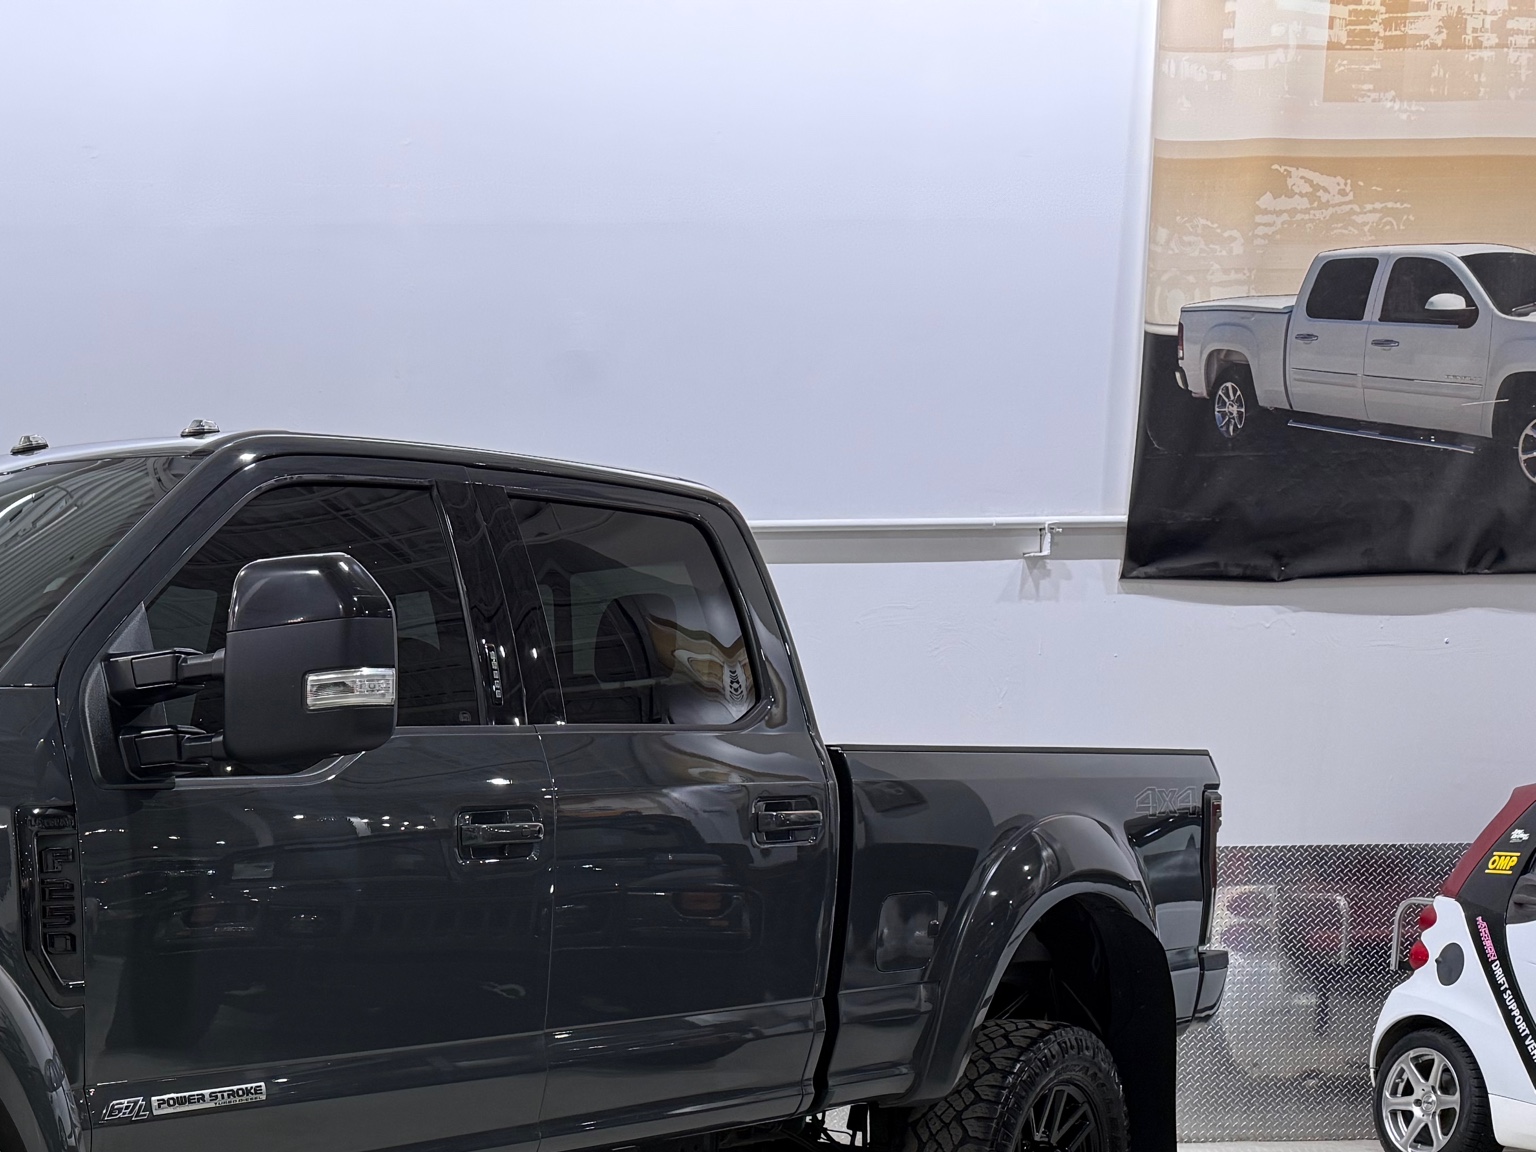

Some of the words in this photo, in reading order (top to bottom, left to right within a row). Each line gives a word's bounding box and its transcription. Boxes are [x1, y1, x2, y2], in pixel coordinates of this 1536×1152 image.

[1488, 855, 1518, 870] OMP
[1491, 960, 1509, 991] DRIFT
[1503, 989, 1530, 1037] SUPPORT
[156, 1093, 206, 1109] POWER
[209, 1085, 263, 1101] STROKE
